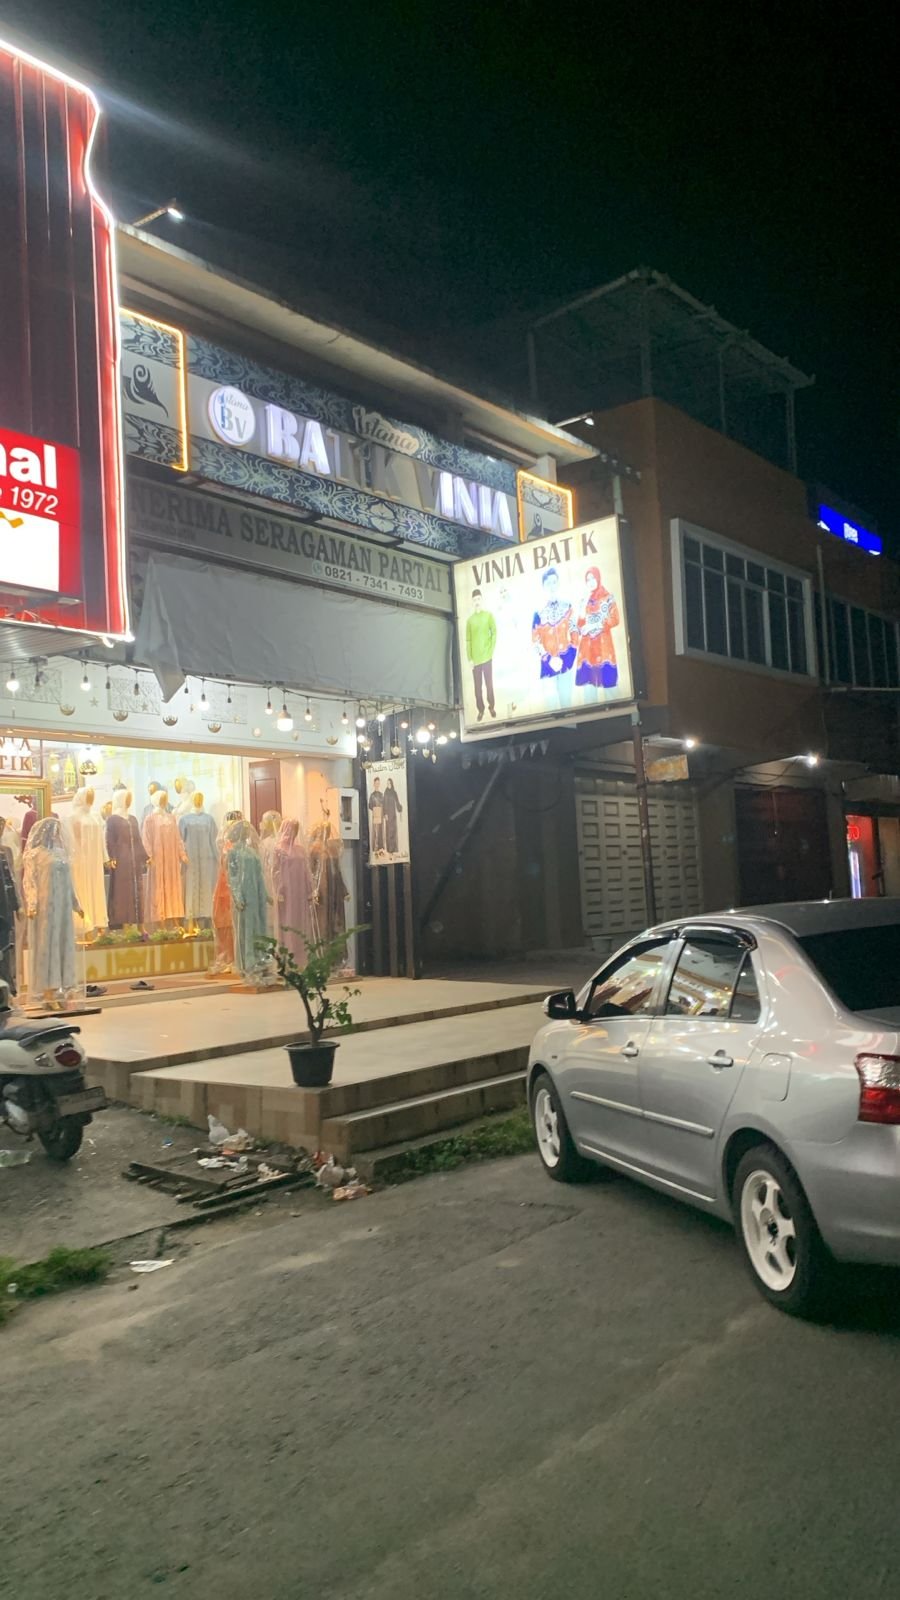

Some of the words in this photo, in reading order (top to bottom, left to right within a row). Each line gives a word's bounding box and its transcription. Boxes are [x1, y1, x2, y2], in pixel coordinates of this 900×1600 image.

[0, 443, 57, 489] al
[10, 486, 58, 515] 1972
[240, 511, 372, 575] SERAGAMAN
[378, 551, 442, 592] PARTAI
[472, 552, 525, 586] VINIA
[324, 565, 352, 582] 0821
[363, 575, 389, 591] 7341
[398, 584, 423, 600] 7493
